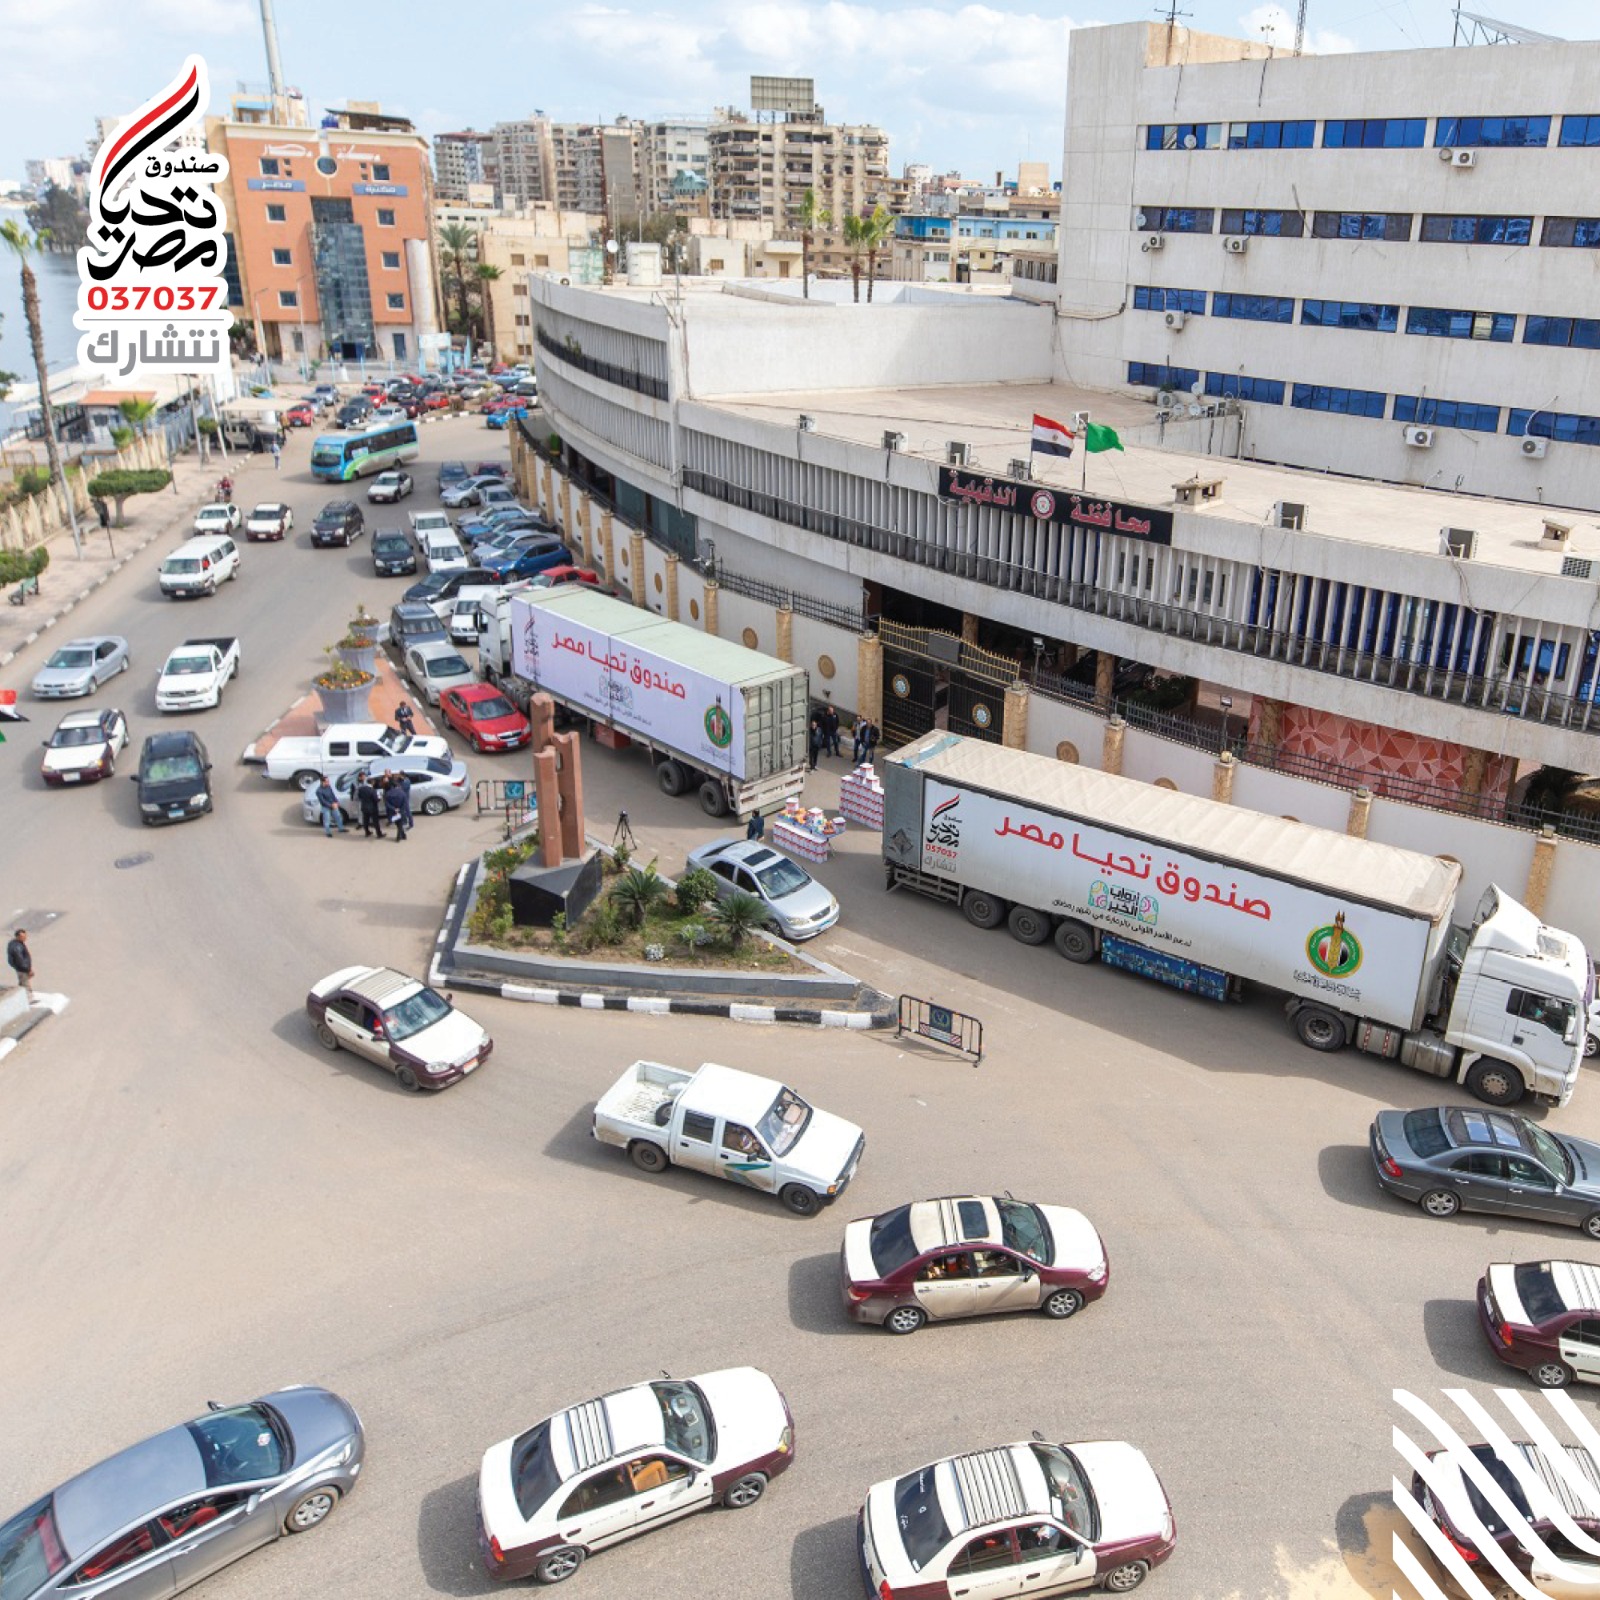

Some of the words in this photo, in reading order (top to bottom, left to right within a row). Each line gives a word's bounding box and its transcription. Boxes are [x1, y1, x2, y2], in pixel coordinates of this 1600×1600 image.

[949, 469, 1016, 505] الدقهلية
[1070, 495, 1150, 534] محافظة
[551, 632, 585, 656] مصر
[588, 640, 627, 673] تحيا
[630, 658, 686, 699] صندوق
[994, 817, 1064, 850] مصر
[1072, 834, 1152, 879] تحيا
[1107, 899, 1138, 917] الخير
[1156, 862, 1271, 921] صندوق
